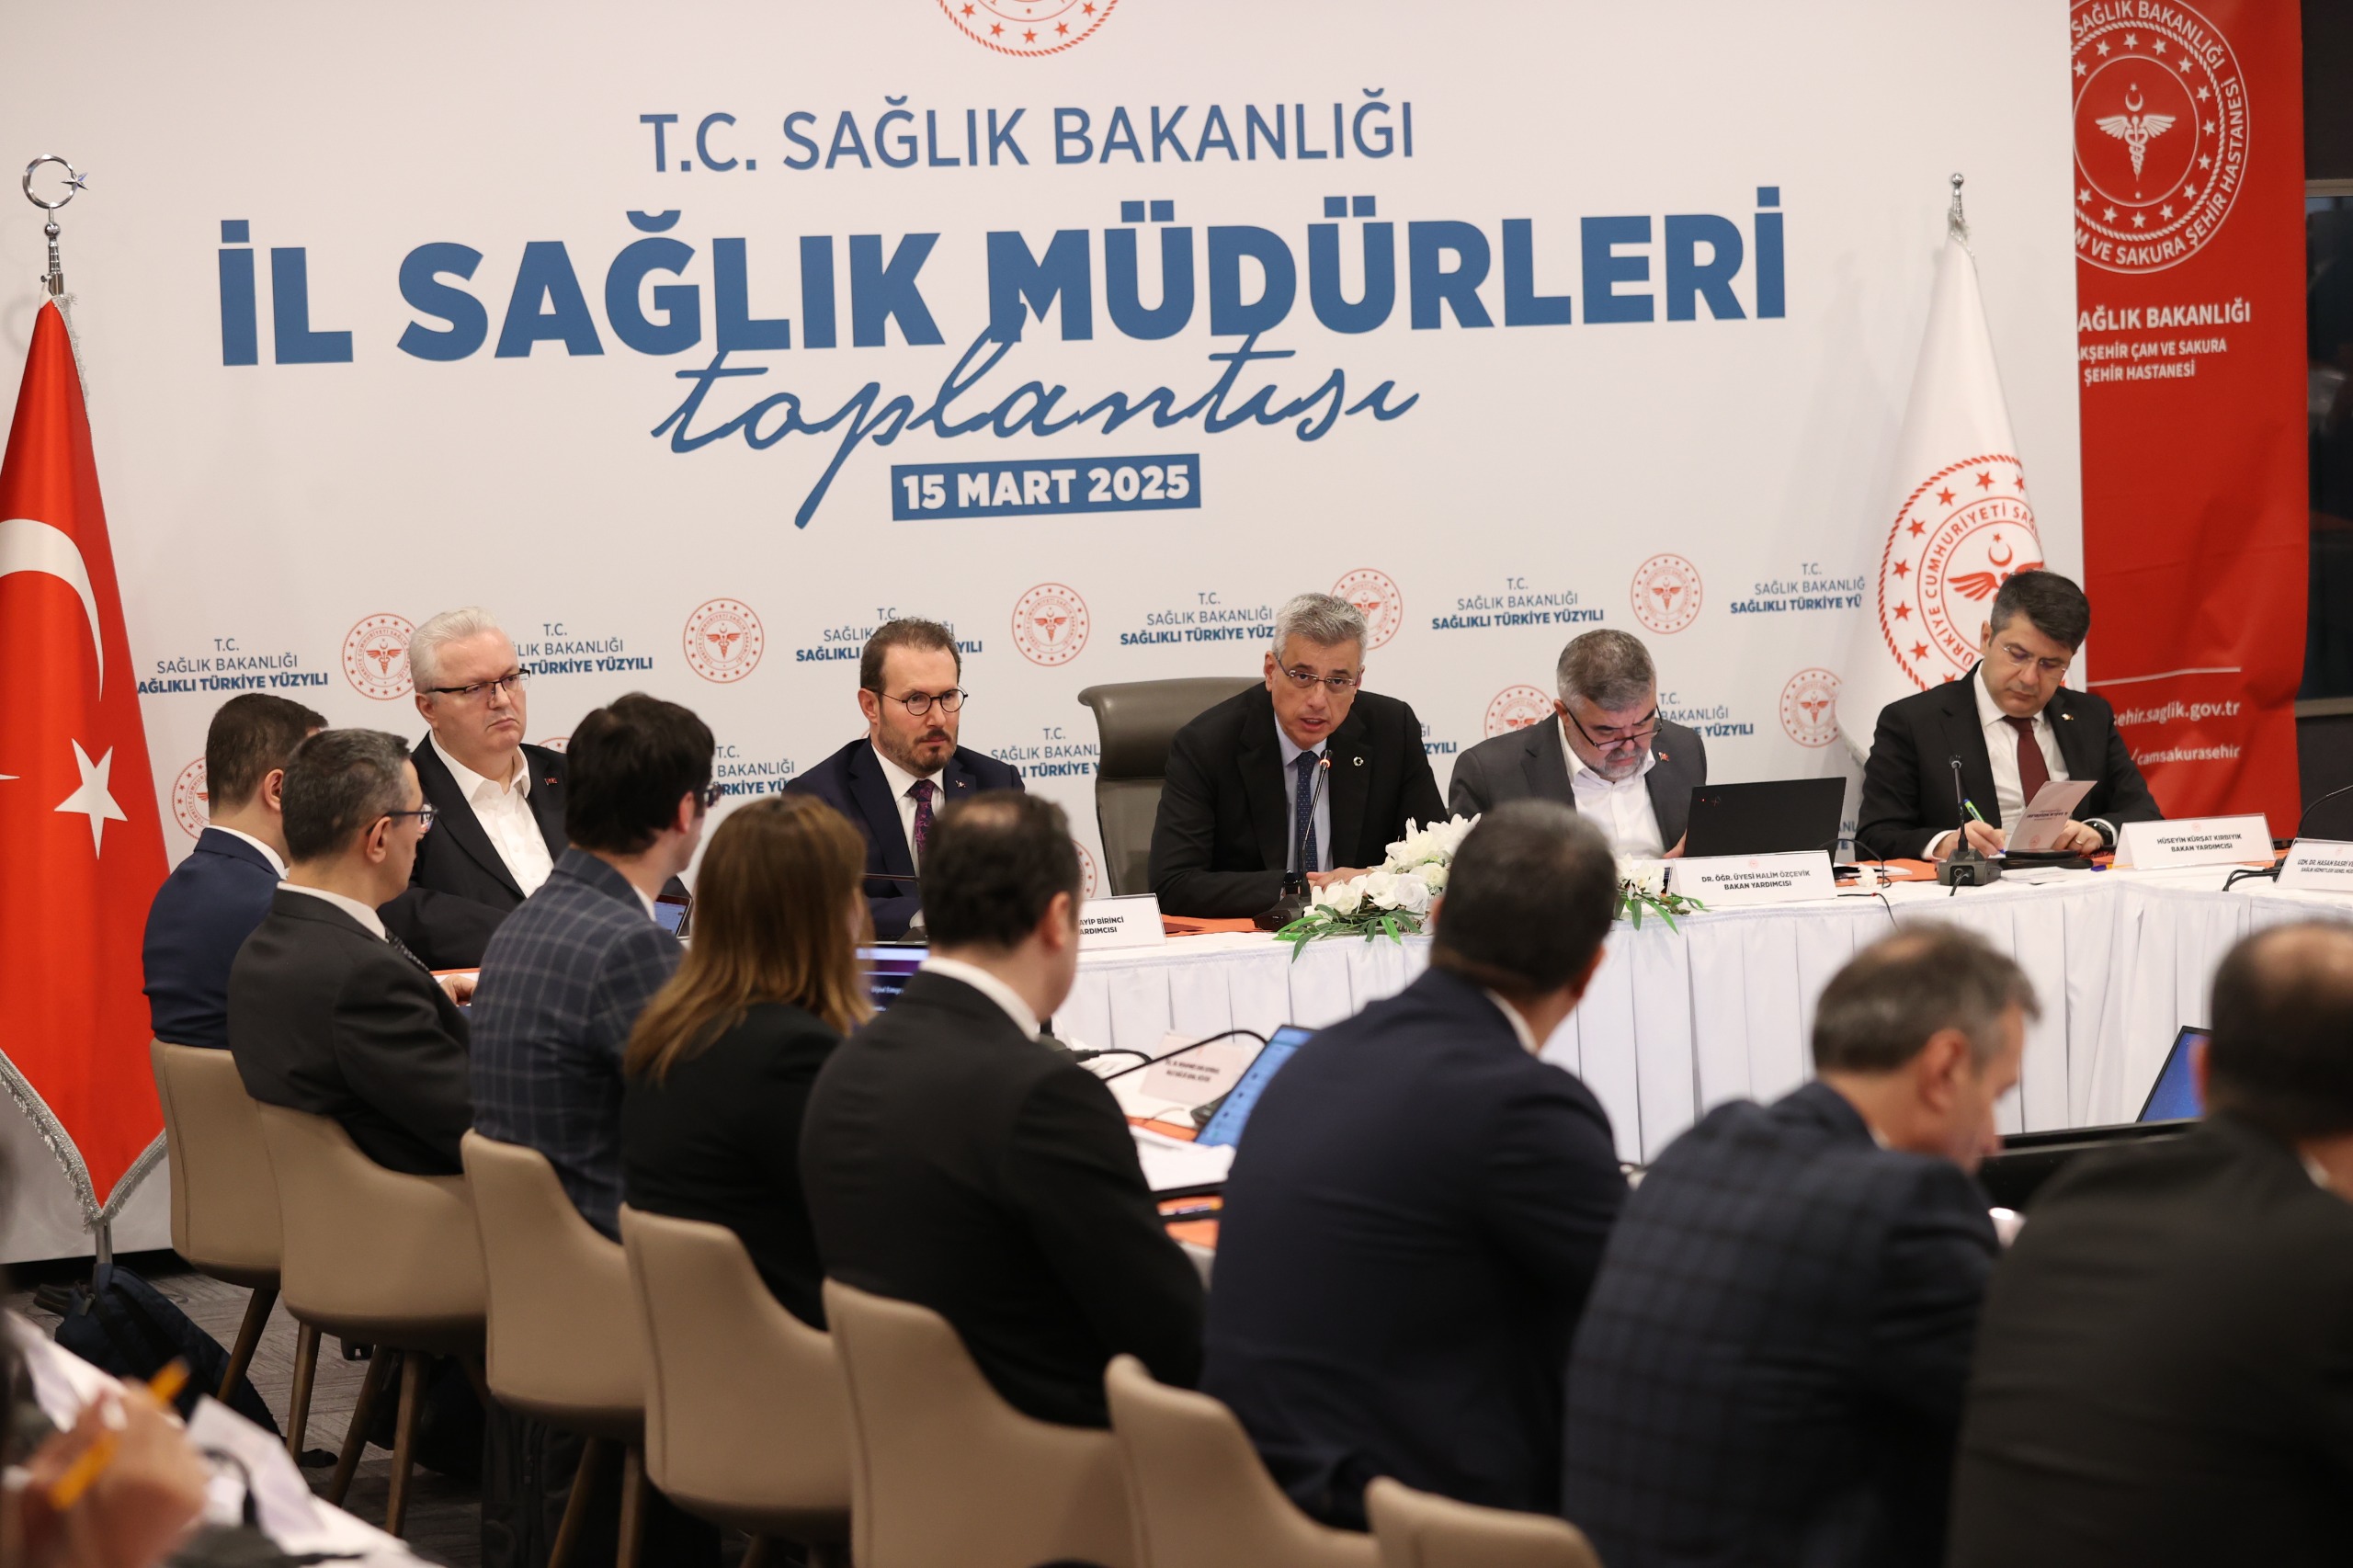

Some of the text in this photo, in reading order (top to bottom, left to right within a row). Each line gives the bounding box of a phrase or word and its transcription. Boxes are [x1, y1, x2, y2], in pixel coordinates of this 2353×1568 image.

[2070, 0, 2225, 70] SAĞLIK BAKANLIĞI
[640, 88, 1413, 172] T.C. SAĞLIK BAKANLIĞI
[2091, 238, 2112, 261] VE
[2116, 236, 2187, 266] SAKURA
[2185, 192, 2228, 247] ŞEHİR
[2220, 75, 2244, 193] HASTANESİ
[218, 186, 1786, 366] İL SAĞLIK MÜDÜRLERİ
[2078, 297, 2251, 332] AĞLIK BAKANLIĞI
[2078, 337, 2227, 364] KŞEHİR ÇAM VE SAKURA
[2084, 359, 2195, 387] ŞEHİR HASTANESİ
[651, 301, 1419, 529] toplantısı
[902, 464, 1190, 510] 15 MART 2025
[1926, 502, 2006, 598] CUMHURİYETİ
[1802, 562, 1823, 575] T.C.
[1507, 577, 1529, 590] T.C.
[1755, 576, 1866, 596] SAĞLIK BAKANLIĞ
[1198, 592, 1221, 605] T.C.
[1457, 590, 1578, 610] SAĞLIK BAKANLIĞI
[1730, 598, 1787, 614] SAĞLIKLI
[1790, 596, 1843, 610] TÜRKİYE
[1147, 606, 1272, 626] SAĞLIK BAKANLIĞI
[1432, 609, 1604, 630] SAĞLIKLI TÜRKİYE YÜZYILI
[543, 623, 568, 636] T.C.
[824, 626, 873, 642] SAĞLIK
[1120, 630, 1182, 645] SAĞLIKLI
[1185, 626, 1244, 642] TÜRKİYE
[1929, 607, 1975, 666] ÜRKİYE
[214, 638, 239, 652] T.C.
[545, 637, 623, 655] BAKANLIĞI
[796, 641, 983, 662] SAĞLIKLI YILI
[157, 652, 298, 674] SAĞLIK BAKANLIĞI
[529, 658, 593, 675] TÜRKİYE
[597, 656, 654, 672] YÜZYILI
[138, 672, 328, 694] AĞLIKLI TÜRKİYE YÜZYILI
[1659, 692, 1680, 705] T.C.
[1661, 705, 1729, 722] BAKANLIĞI
[1042, 727, 1066, 740] T.C.
[1705, 723, 1754, 737] YÜZYILI
[716, 745, 740, 759] T.C.
[991, 744, 1100, 761] SAĞLIK BAKANL
[1424, 742, 1457, 755] ZYILI
[718, 758, 794, 778] BAKANLIĞI
[1029, 761, 1089, 778] TÜRKİYE
[2157, 834, 2242, 845] HÜSEYİN KÜRŞAT KIRBIYIK
[2196, 843, 2234, 851] YARDIMCISI
[1733, 872, 1756, 881] ÜYESİ
[1756, 871, 1779, 880] HALİM
[1779, 870, 1811, 879] ÖZÇEVİK
[1724, 880, 1791, 891] BAKAN YARDIMCISI
[1079, 915, 1124, 926] AYİP BİRİNCİ
[1079, 926, 1118, 935] ARDIMCISI
